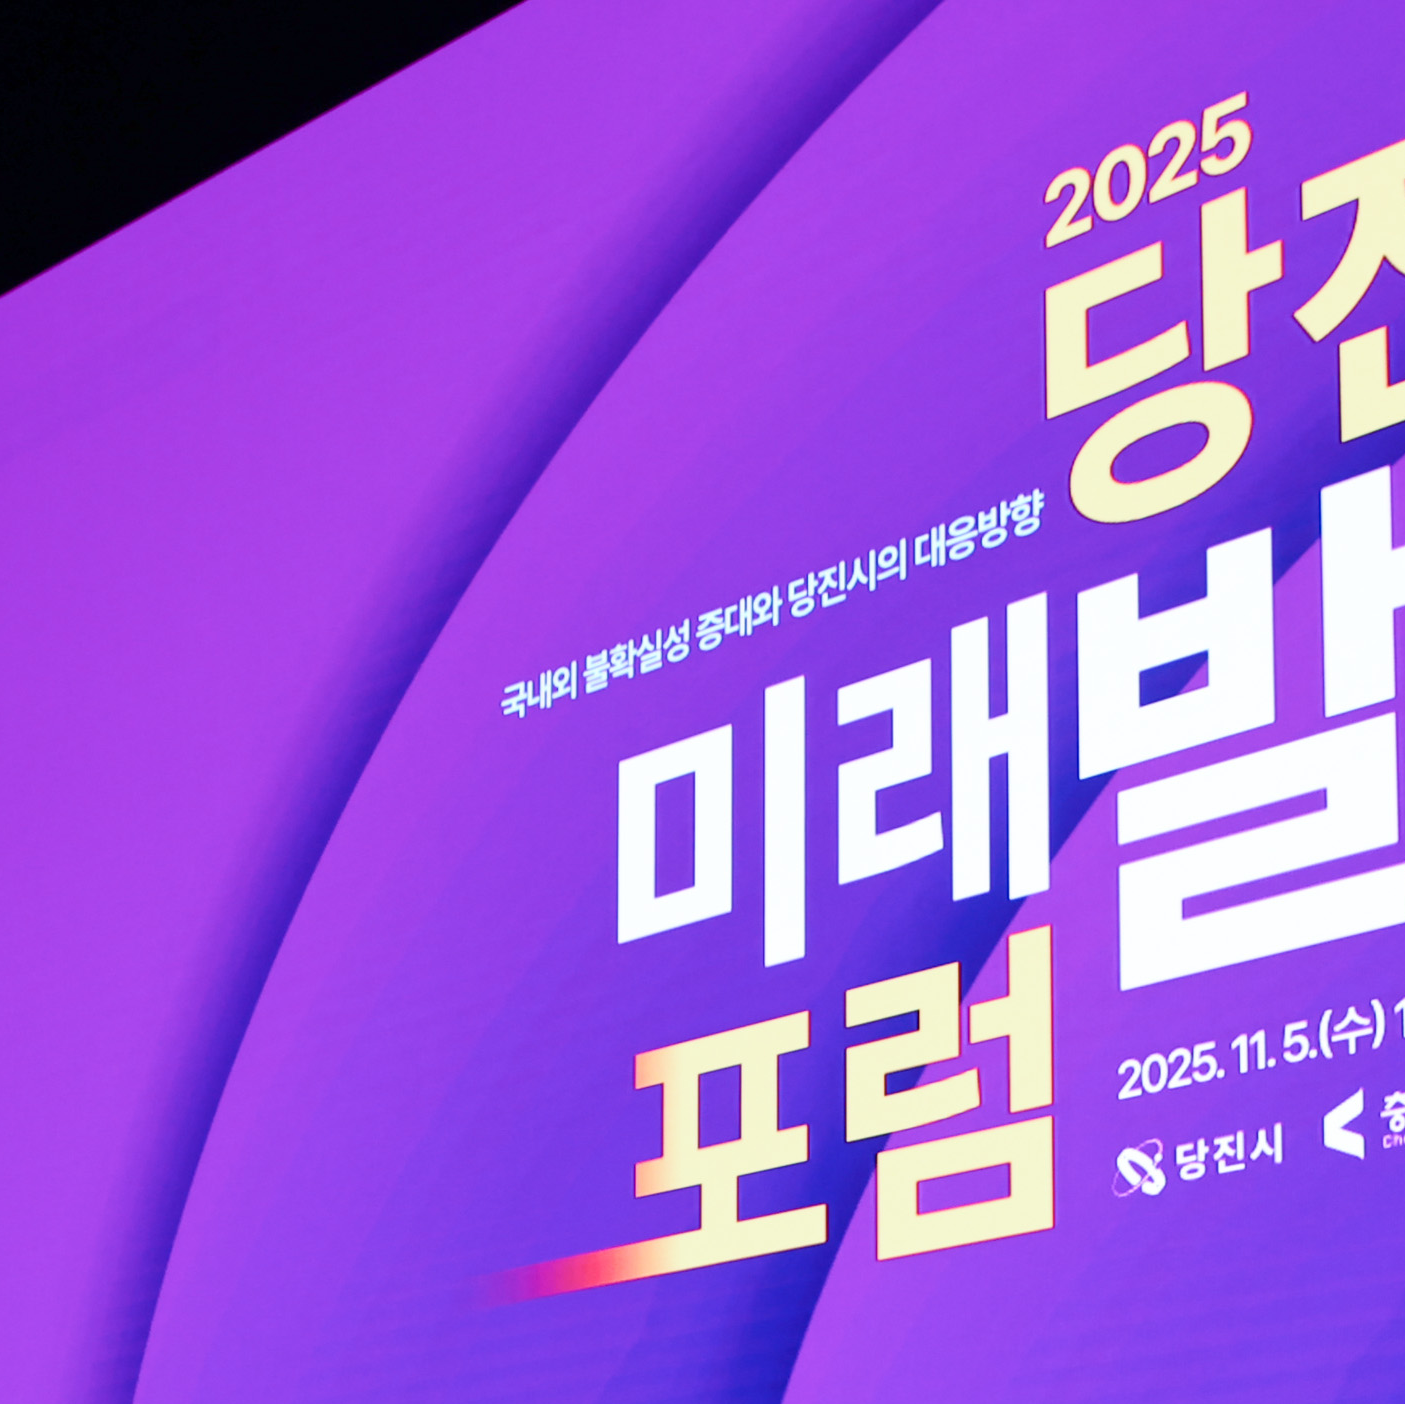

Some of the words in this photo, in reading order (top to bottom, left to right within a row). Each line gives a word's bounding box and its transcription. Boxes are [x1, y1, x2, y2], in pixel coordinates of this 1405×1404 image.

[1043, 91, 1254, 249] 2025
[500, 660, 578, 718] 국내외
[582, 617, 691, 694] 불확실성
[695, 584, 783, 652] 증대와
[787, 538, 908, 619] 당진시의
[913, 487, 1045, 568] 대응방향
[626, 923, 1056, 1262] 포럼
[1117, 1041, 1225, 1100] 2025.
[1231, 1029, 1277, 1074] 11.
[1174, 1121, 1284, 1181] 당진시
